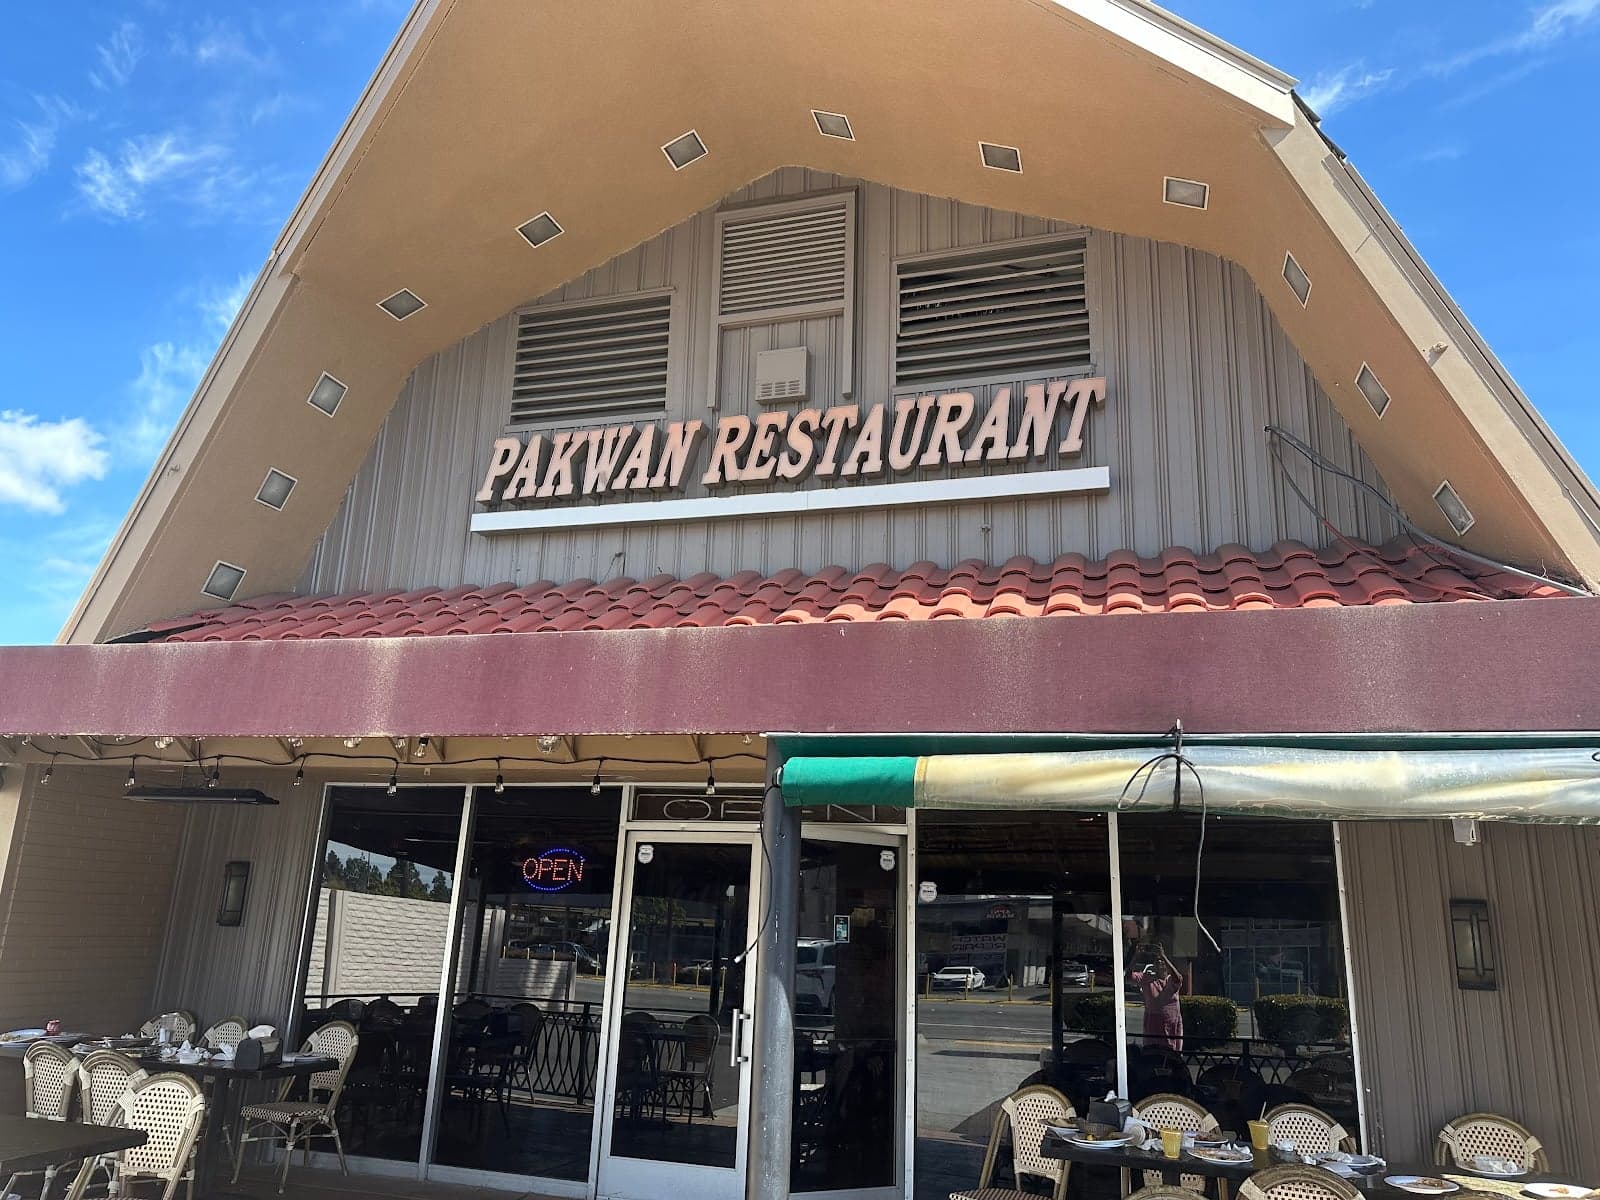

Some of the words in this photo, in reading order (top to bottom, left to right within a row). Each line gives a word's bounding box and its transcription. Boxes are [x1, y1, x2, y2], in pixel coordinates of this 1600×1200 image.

[476, 420, 703, 503] PAKWAN
[703, 377, 1106, 486] RESTAURANT
[664, 799, 876, 822] OPN
[522, 858, 585, 882] OPEN
